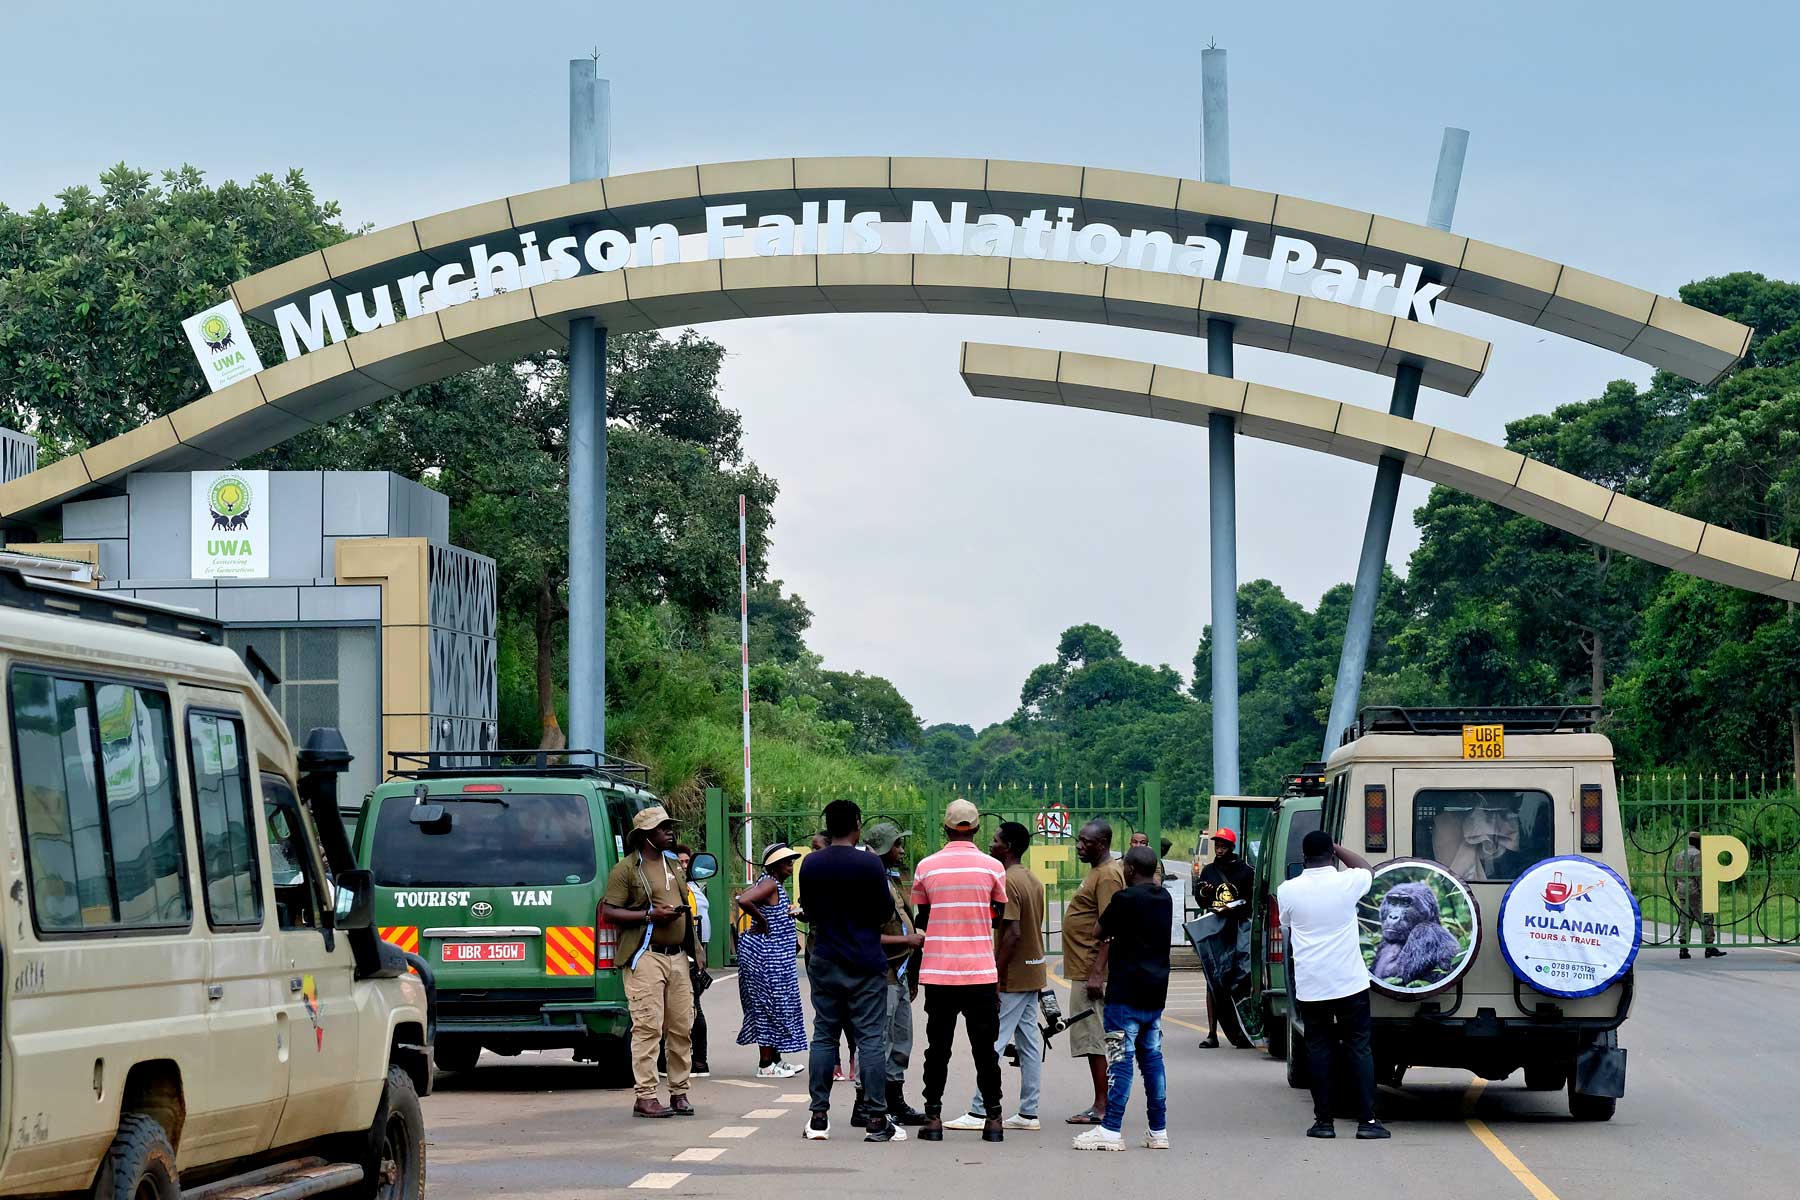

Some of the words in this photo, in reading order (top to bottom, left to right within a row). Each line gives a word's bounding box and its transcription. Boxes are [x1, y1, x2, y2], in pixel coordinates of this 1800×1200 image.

[273, 222, 681, 361] Murchison
[705, 200, 882, 259] Falls
[911, 201, 1249, 282] National
[1265, 235, 1447, 323] Park
[213, 351, 245, 371] UWA
[208, 540, 252, 556] UWA
[1475, 728, 1502, 742] UBF
[1468, 744, 1502, 758] 316B
[1701, 835, 1749, 913] P
[394, 891, 470, 908] TOURIST
[511, 891, 552, 906] VAN
[1524, 915, 1620, 937] KULANAMA
[1529, 932, 1559, 941] TOURS
[1570, 936, 1601, 946] TRAVEL
[458, 945, 481, 959] UBR
[488, 945, 518, 959] 150W
